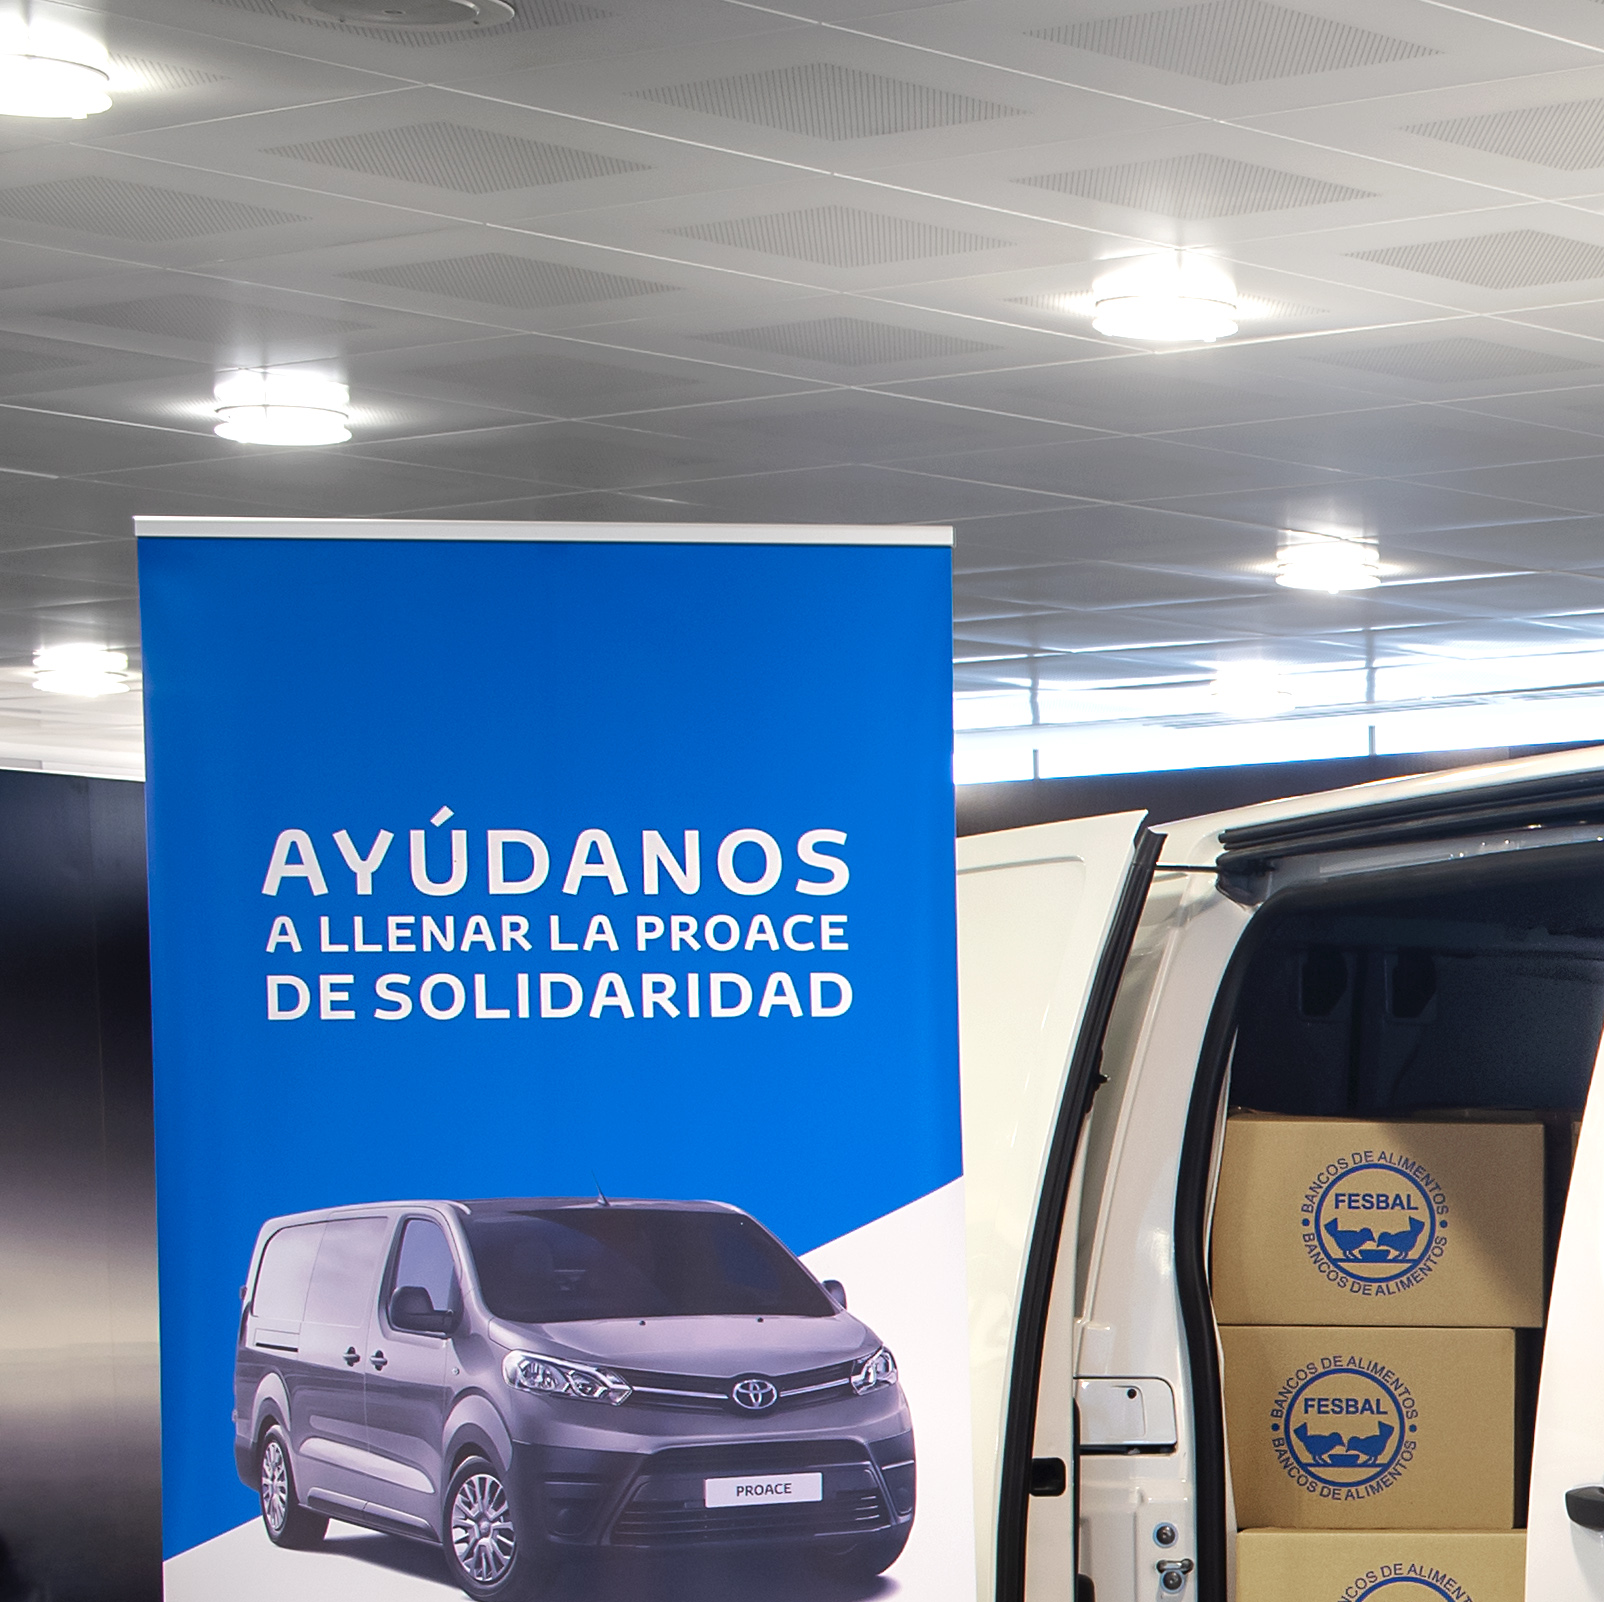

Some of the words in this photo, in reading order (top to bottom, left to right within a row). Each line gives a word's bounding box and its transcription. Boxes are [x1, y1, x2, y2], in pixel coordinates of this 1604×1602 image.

[261, 805, 850, 897] AYÚDANOS
[266, 915, 302, 953] A
[320, 914, 532, 953] LLENAR
[549, 914, 620, 952] LA
[636, 914, 849, 952] PROACE
[266, 973, 356, 1021] DE
[373, 971, 853, 1021] SOLIDARIDAD
[1301, 1158, 1349, 1213] BANCOS
[1352, 1151, 1374, 1165] DE
[1378, 1151, 1449, 1215] ALIMENTOS
[1334, 1193, 1419, 1210] FESBAL
[1303, 1233, 1348, 1288] BANCOS
[1350, 1281, 1372, 1296] DE
[1375, 1235, 1448, 1296] ALIMENTOS
[1270, 1362, 1318, 1419] BANCOS
[1321, 1355, 1343, 1370] DE
[1347, 1355, 1418, 1419] ALIMENTOS
[1303, 1397, 1388, 1415] FESBAL
[736, 1483, 792, 1497] PROACE
[1272, 1437, 1318, 1493] BANCOS
[1319, 1486, 1341, 1500] DE
[1345, 1440, 1417, 1500] ALIMENTOS
[1380, 1563, 1403, 1578] DE
